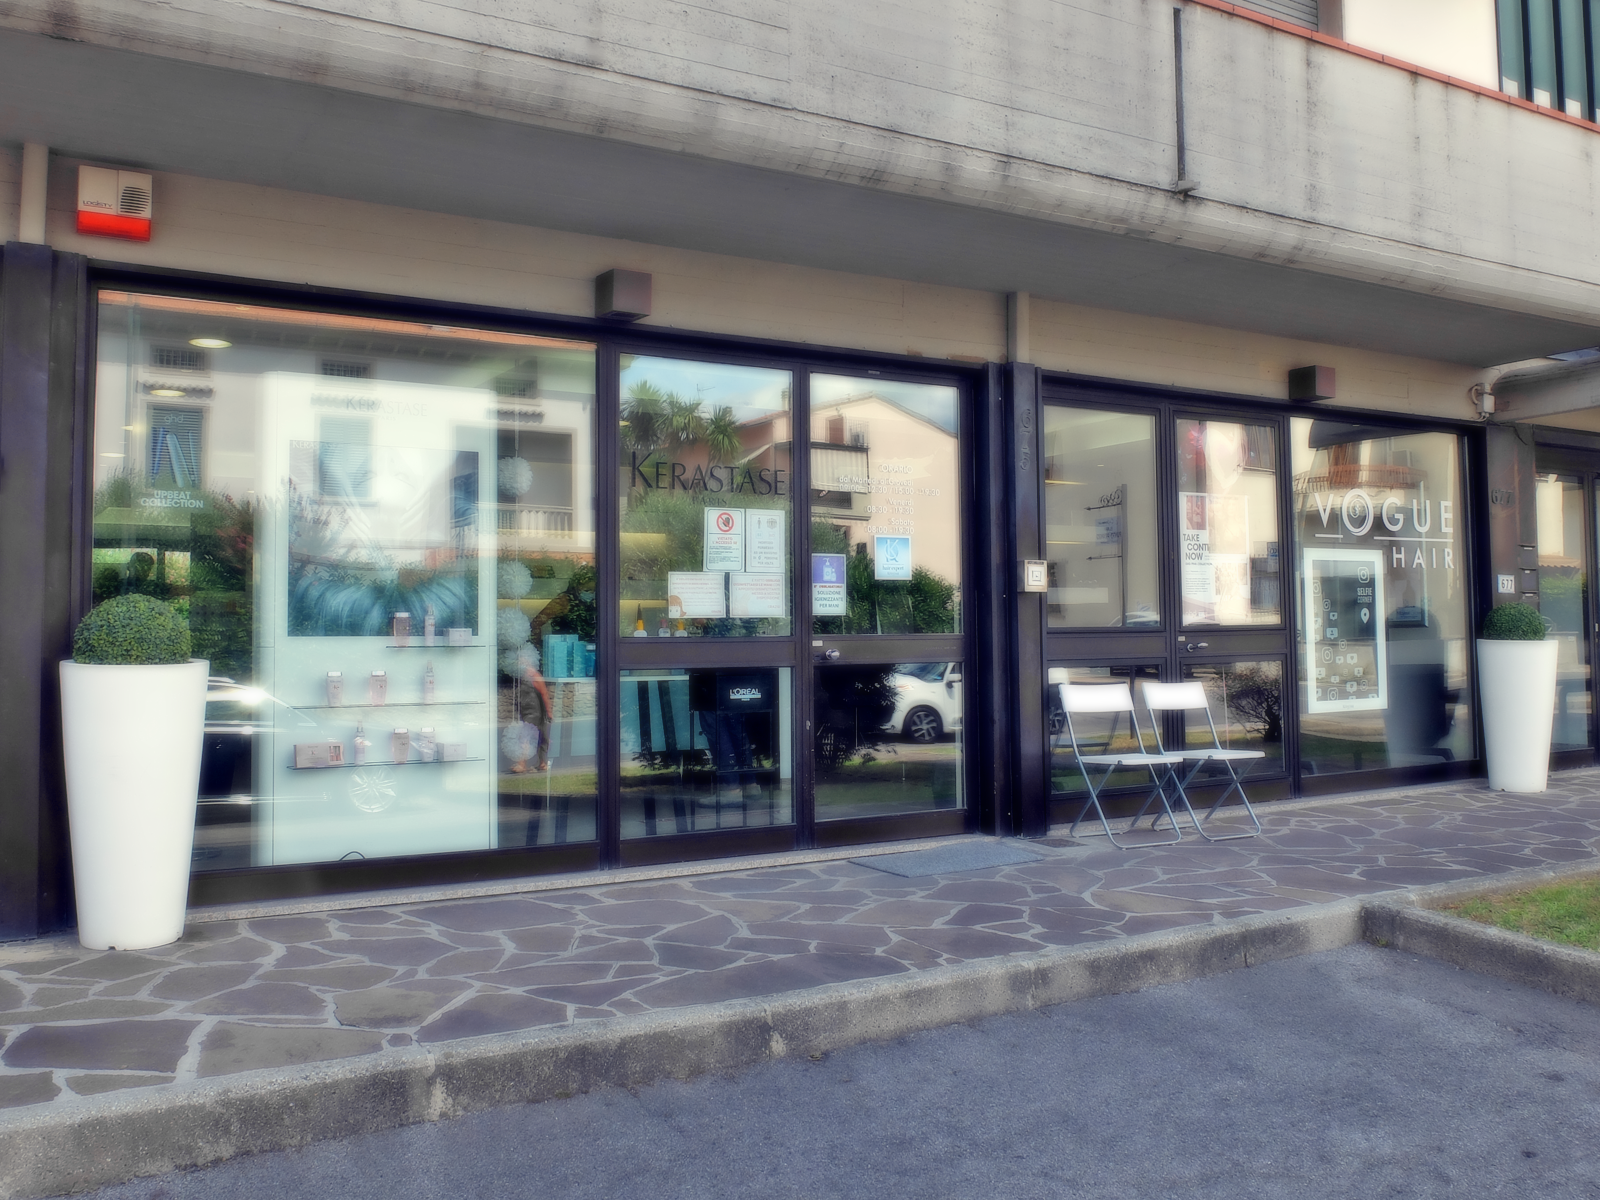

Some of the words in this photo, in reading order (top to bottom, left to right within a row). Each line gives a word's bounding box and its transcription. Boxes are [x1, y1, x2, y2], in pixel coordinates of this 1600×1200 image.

[880, 463, 914, 474] ORARIO
[154, 490, 191, 500] UPBEAT
[1491, 489, 1515, 506] 677
[140, 498, 204, 508] COLLECTION
[1314, 488, 1454, 537] VOGUE
[890, 517, 915, 526] Sabato
[1183, 533, 1200, 542] TAKE
[1185, 552, 1203, 561] NOW
[1392, 547, 1455, 569] HAIR
[1500, 578, 1513, 591] 677
[1357, 587, 1373, 596] SELFIE
[1357, 596, 1373, 604] CORNER
[730, 687, 762, 697] L'ORÉAL
